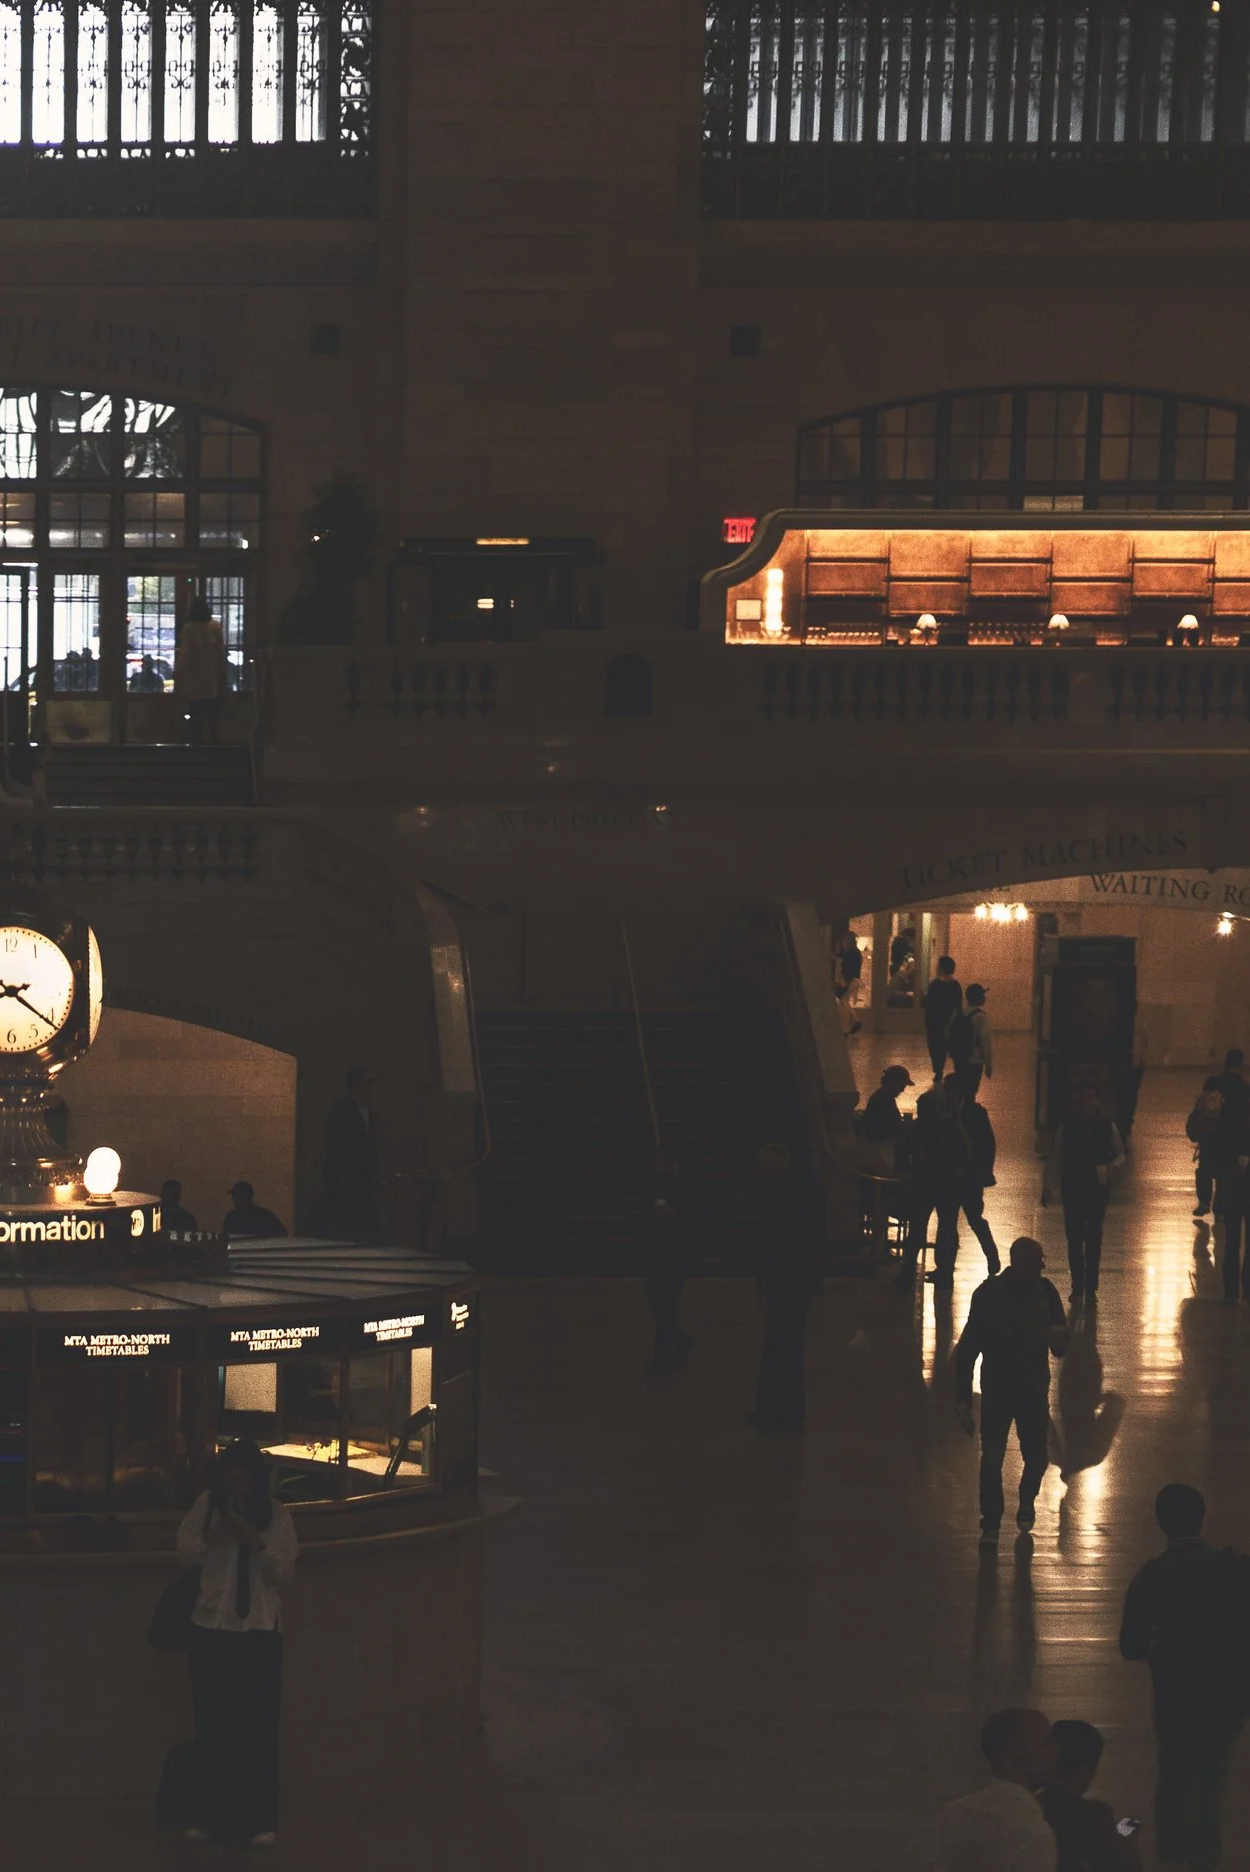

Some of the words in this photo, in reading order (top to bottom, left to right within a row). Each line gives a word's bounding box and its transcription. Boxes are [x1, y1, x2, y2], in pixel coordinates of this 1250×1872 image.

[895, 849, 1008, 890] TICKET
[1023, 831, 1188, 869] MACHINES
[1090, 873, 1210, 900] WAITING
[6, 937, 18, 953] 12
[6, 1029, 17, 1044] 6
[29, 1024, 39, 1039] 5
[64, 1335, 87, 1346] MTA
[90, 1334, 170, 1346] METRO-NORTH
[230, 1331, 250, 1341] MTA
[252, 1326, 320, 1340] METRO-NORTH
[85, 1345, 149, 1356] TIMETABLES
[248, 1338, 302, 1351] TIMETABLES
